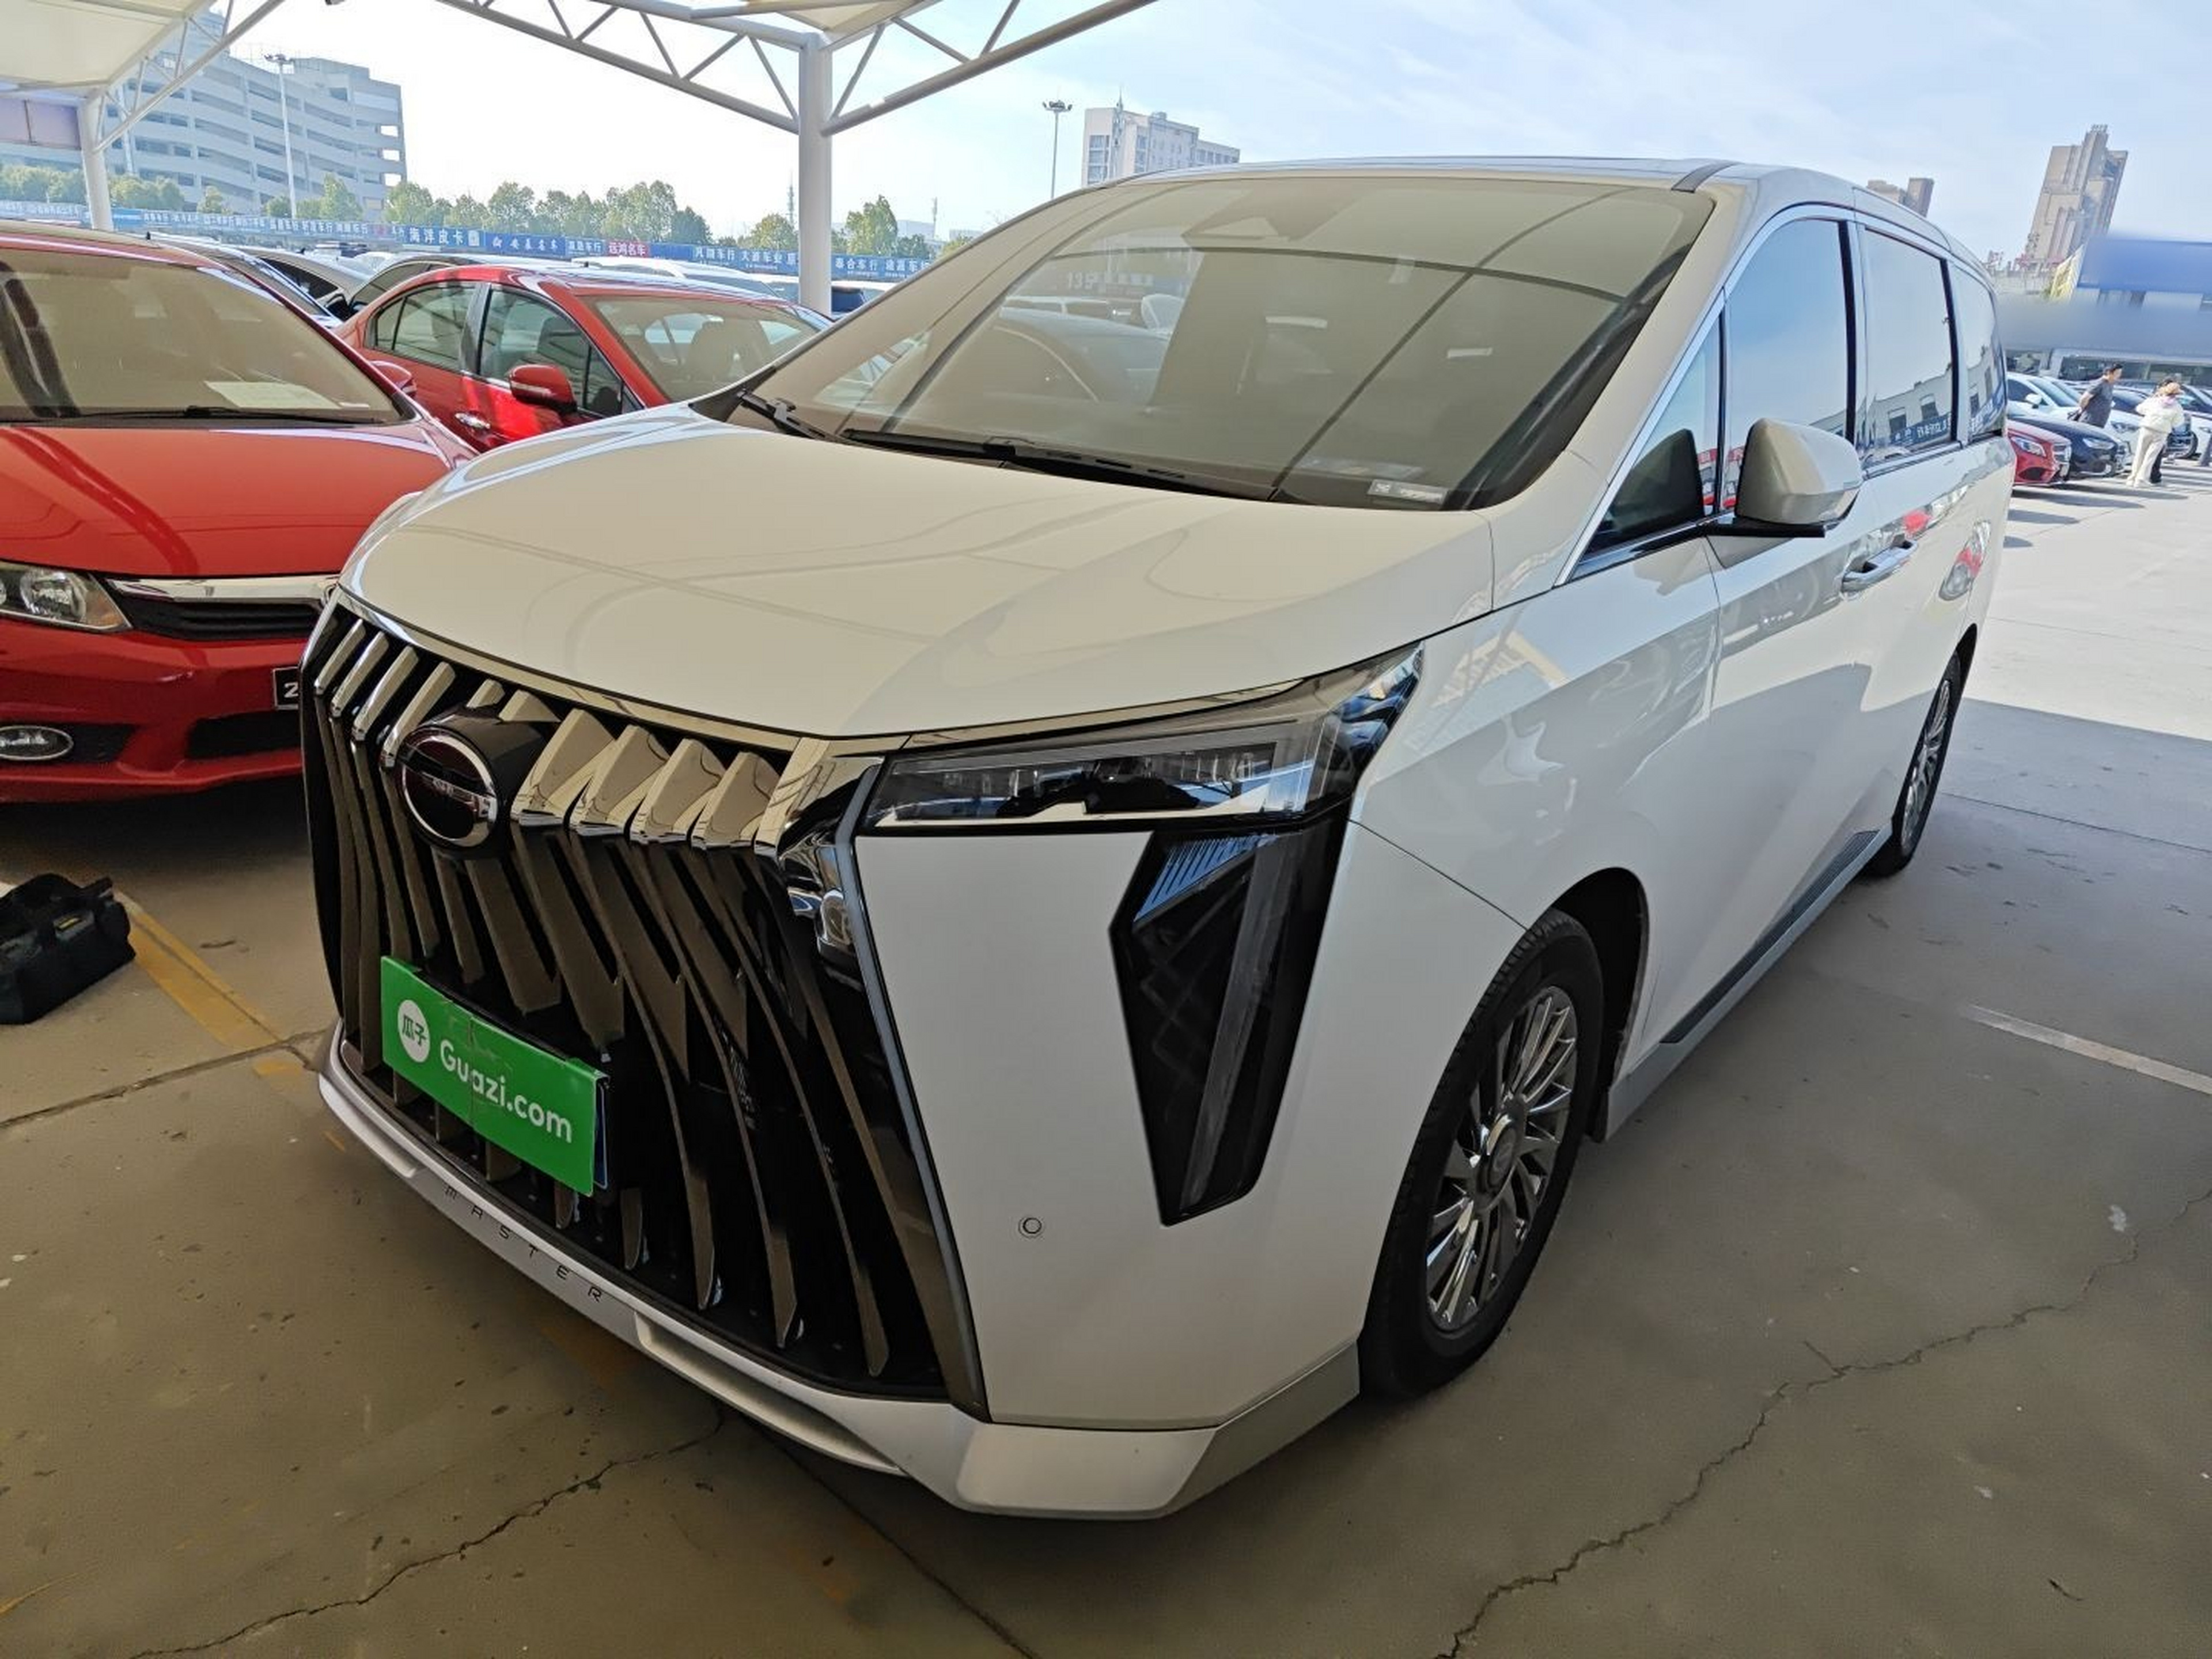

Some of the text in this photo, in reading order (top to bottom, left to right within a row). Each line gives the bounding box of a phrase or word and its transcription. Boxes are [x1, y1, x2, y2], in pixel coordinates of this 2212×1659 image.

[408, 226, 464, 246] 海洋皮卡
[402, 1014, 427, 1047] 瓜子
[440, 1039, 572, 1144] Guazi.com
[442, 1185, 603, 1303] MASTER
